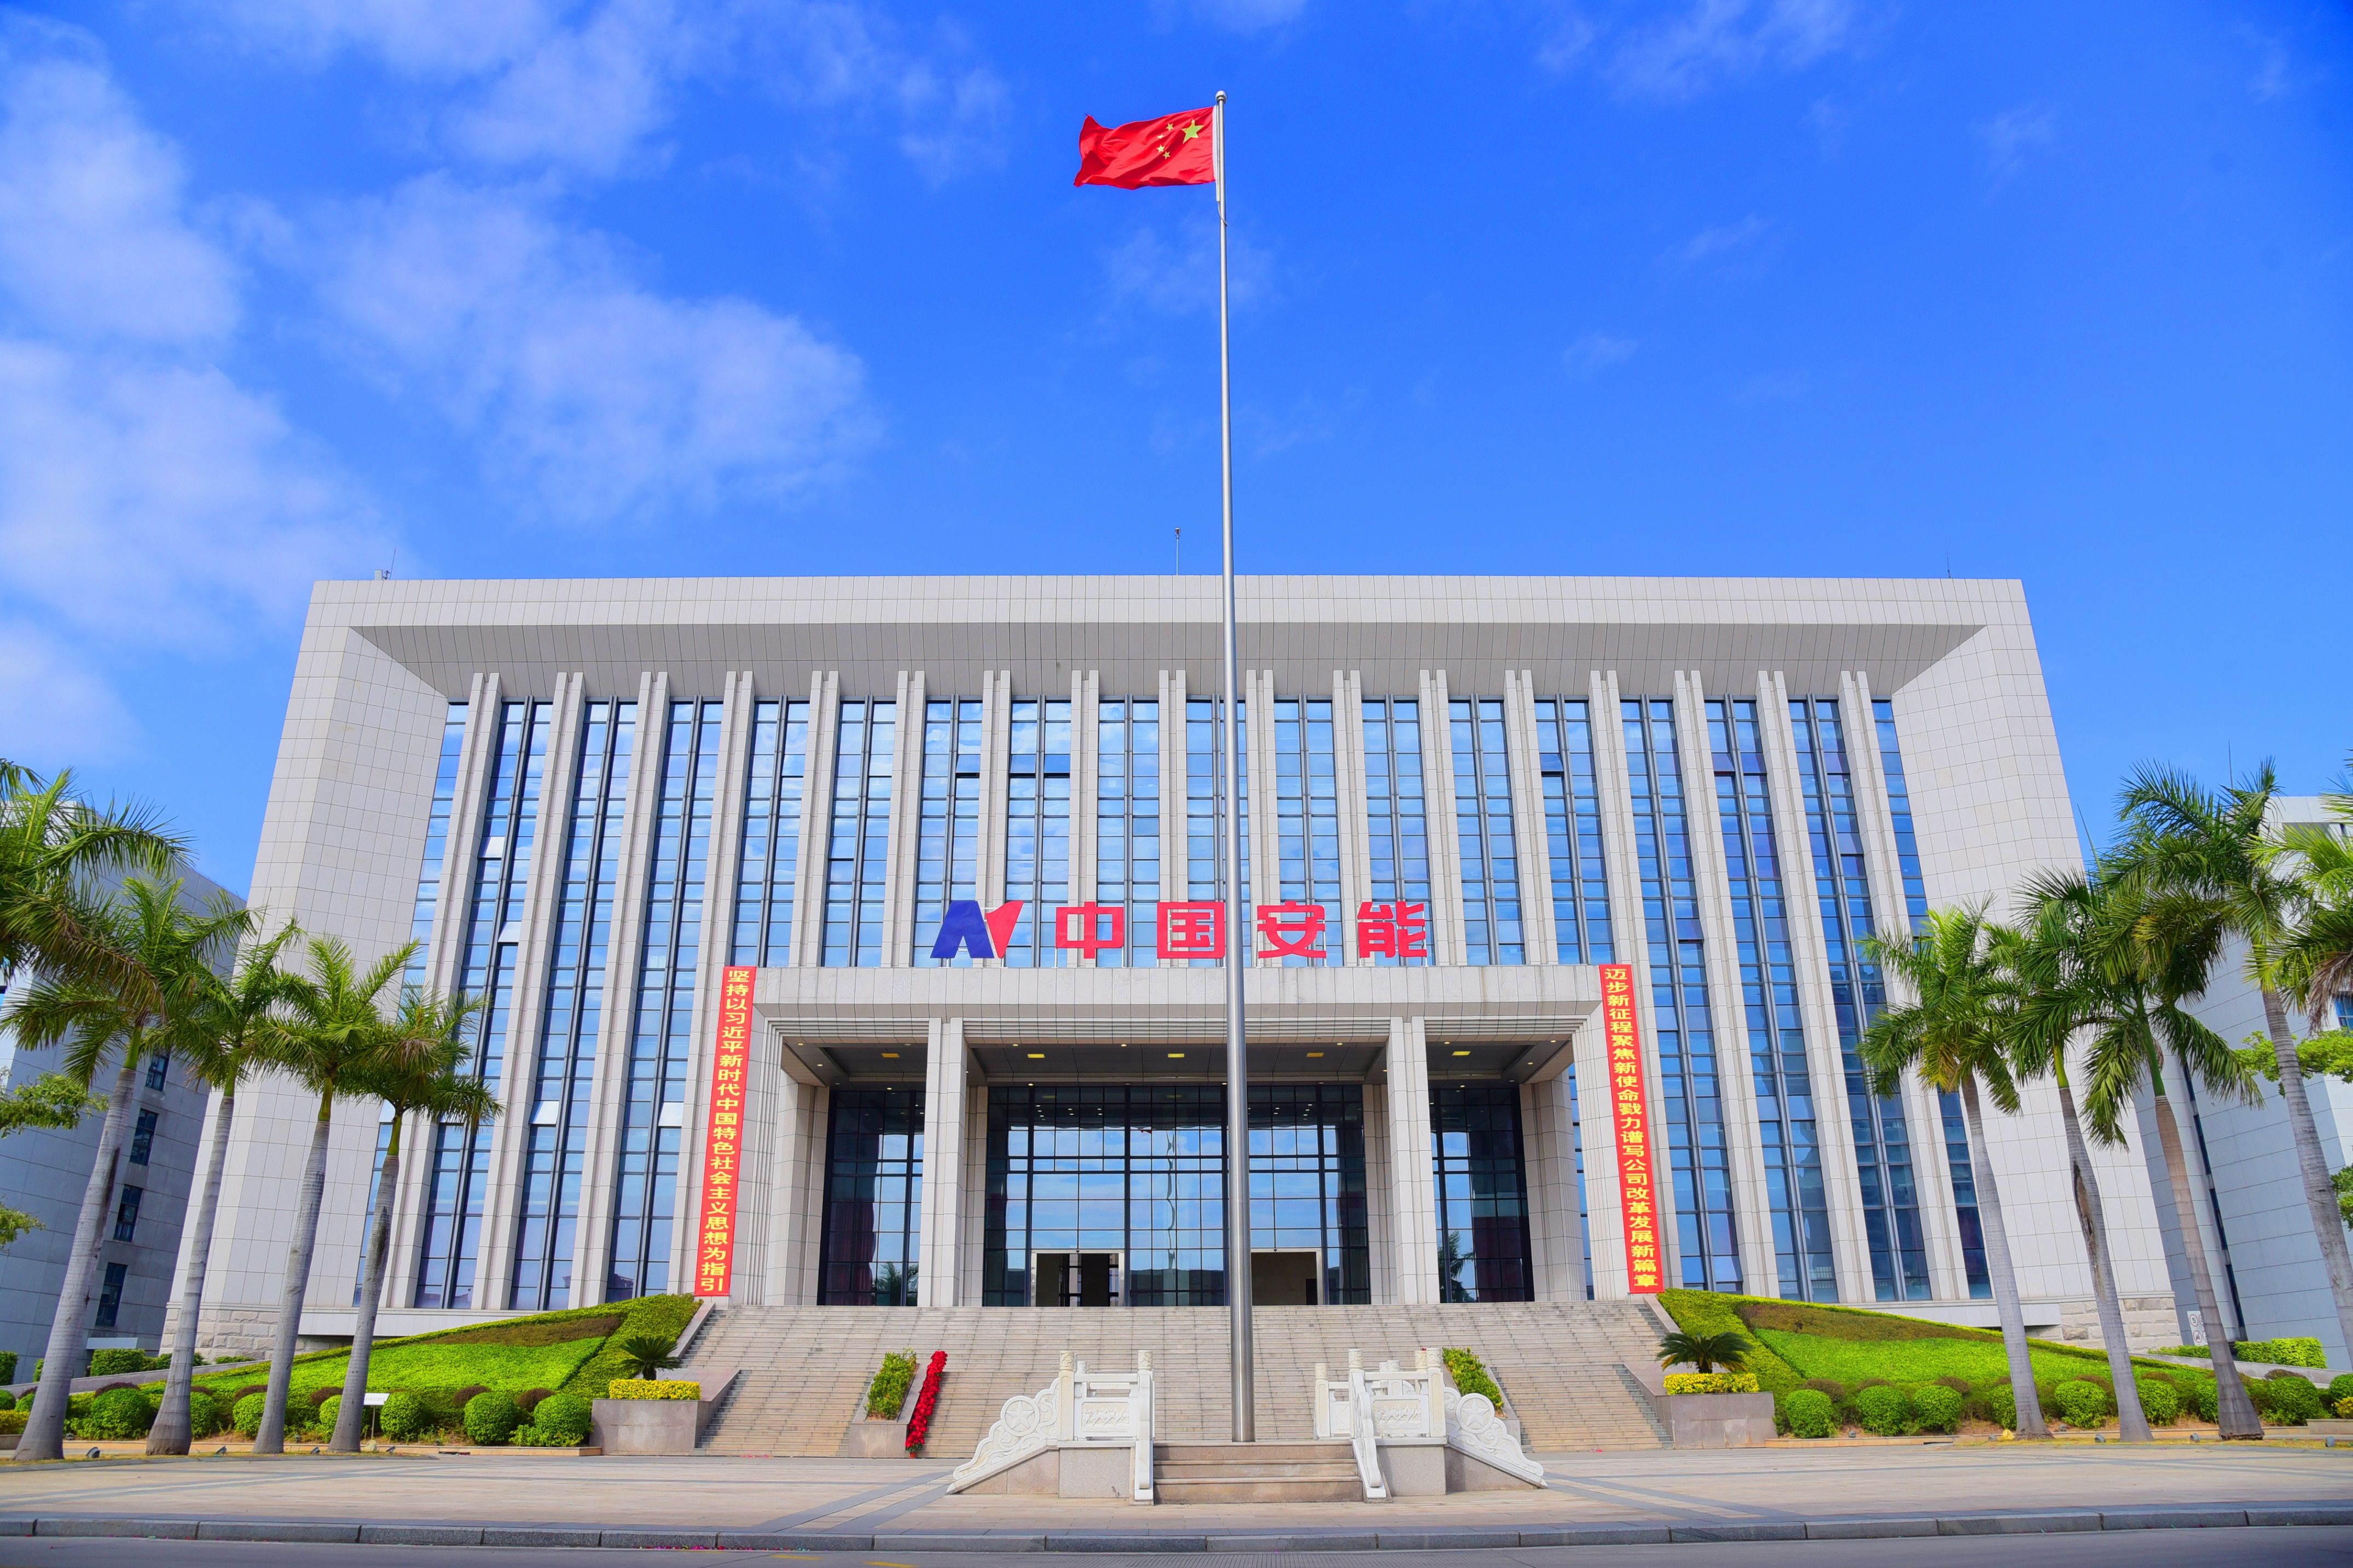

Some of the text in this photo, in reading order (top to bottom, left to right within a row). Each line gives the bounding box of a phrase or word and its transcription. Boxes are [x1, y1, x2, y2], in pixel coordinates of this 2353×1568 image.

[1056, 901, 1427, 959] 中国安能
[700, 970, 750, 1292] 坚持以习近平新时代中国特色社会主义思想为指引
[1604, 968, 1658, 1287] 迈步新征程聚焦新使命戮力谱写公司改革发展新篇章
